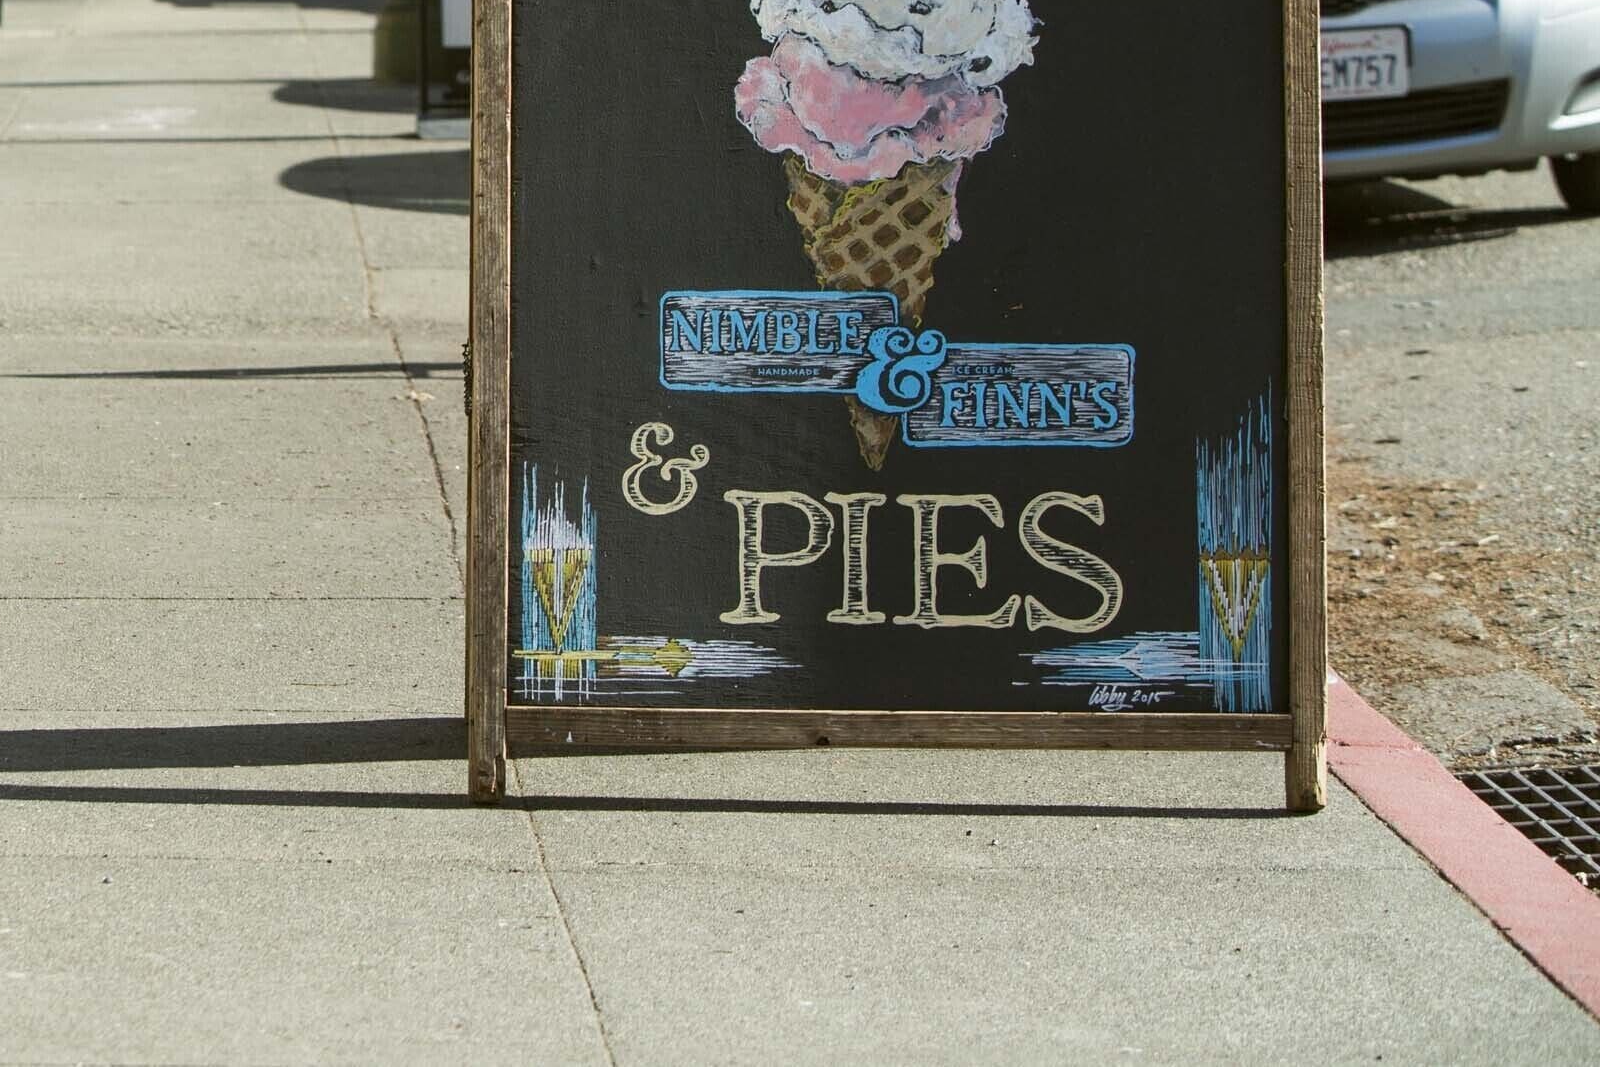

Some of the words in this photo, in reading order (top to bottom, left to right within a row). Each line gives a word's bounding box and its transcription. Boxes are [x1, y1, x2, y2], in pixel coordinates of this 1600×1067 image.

[669, 309, 865, 355] NIMBLE
[856, 326, 947, 414] &
[939, 380, 1120, 430] FINN'S
[757, 367, 821, 377] HANDMADE
[951, 365, 970, 375] ICE
[975, 365, 1012, 376] CREAM
[622, 422, 710, 515] &
[719, 489, 1123, 632] PIES
[1131, 690, 1175, 705] 2015
